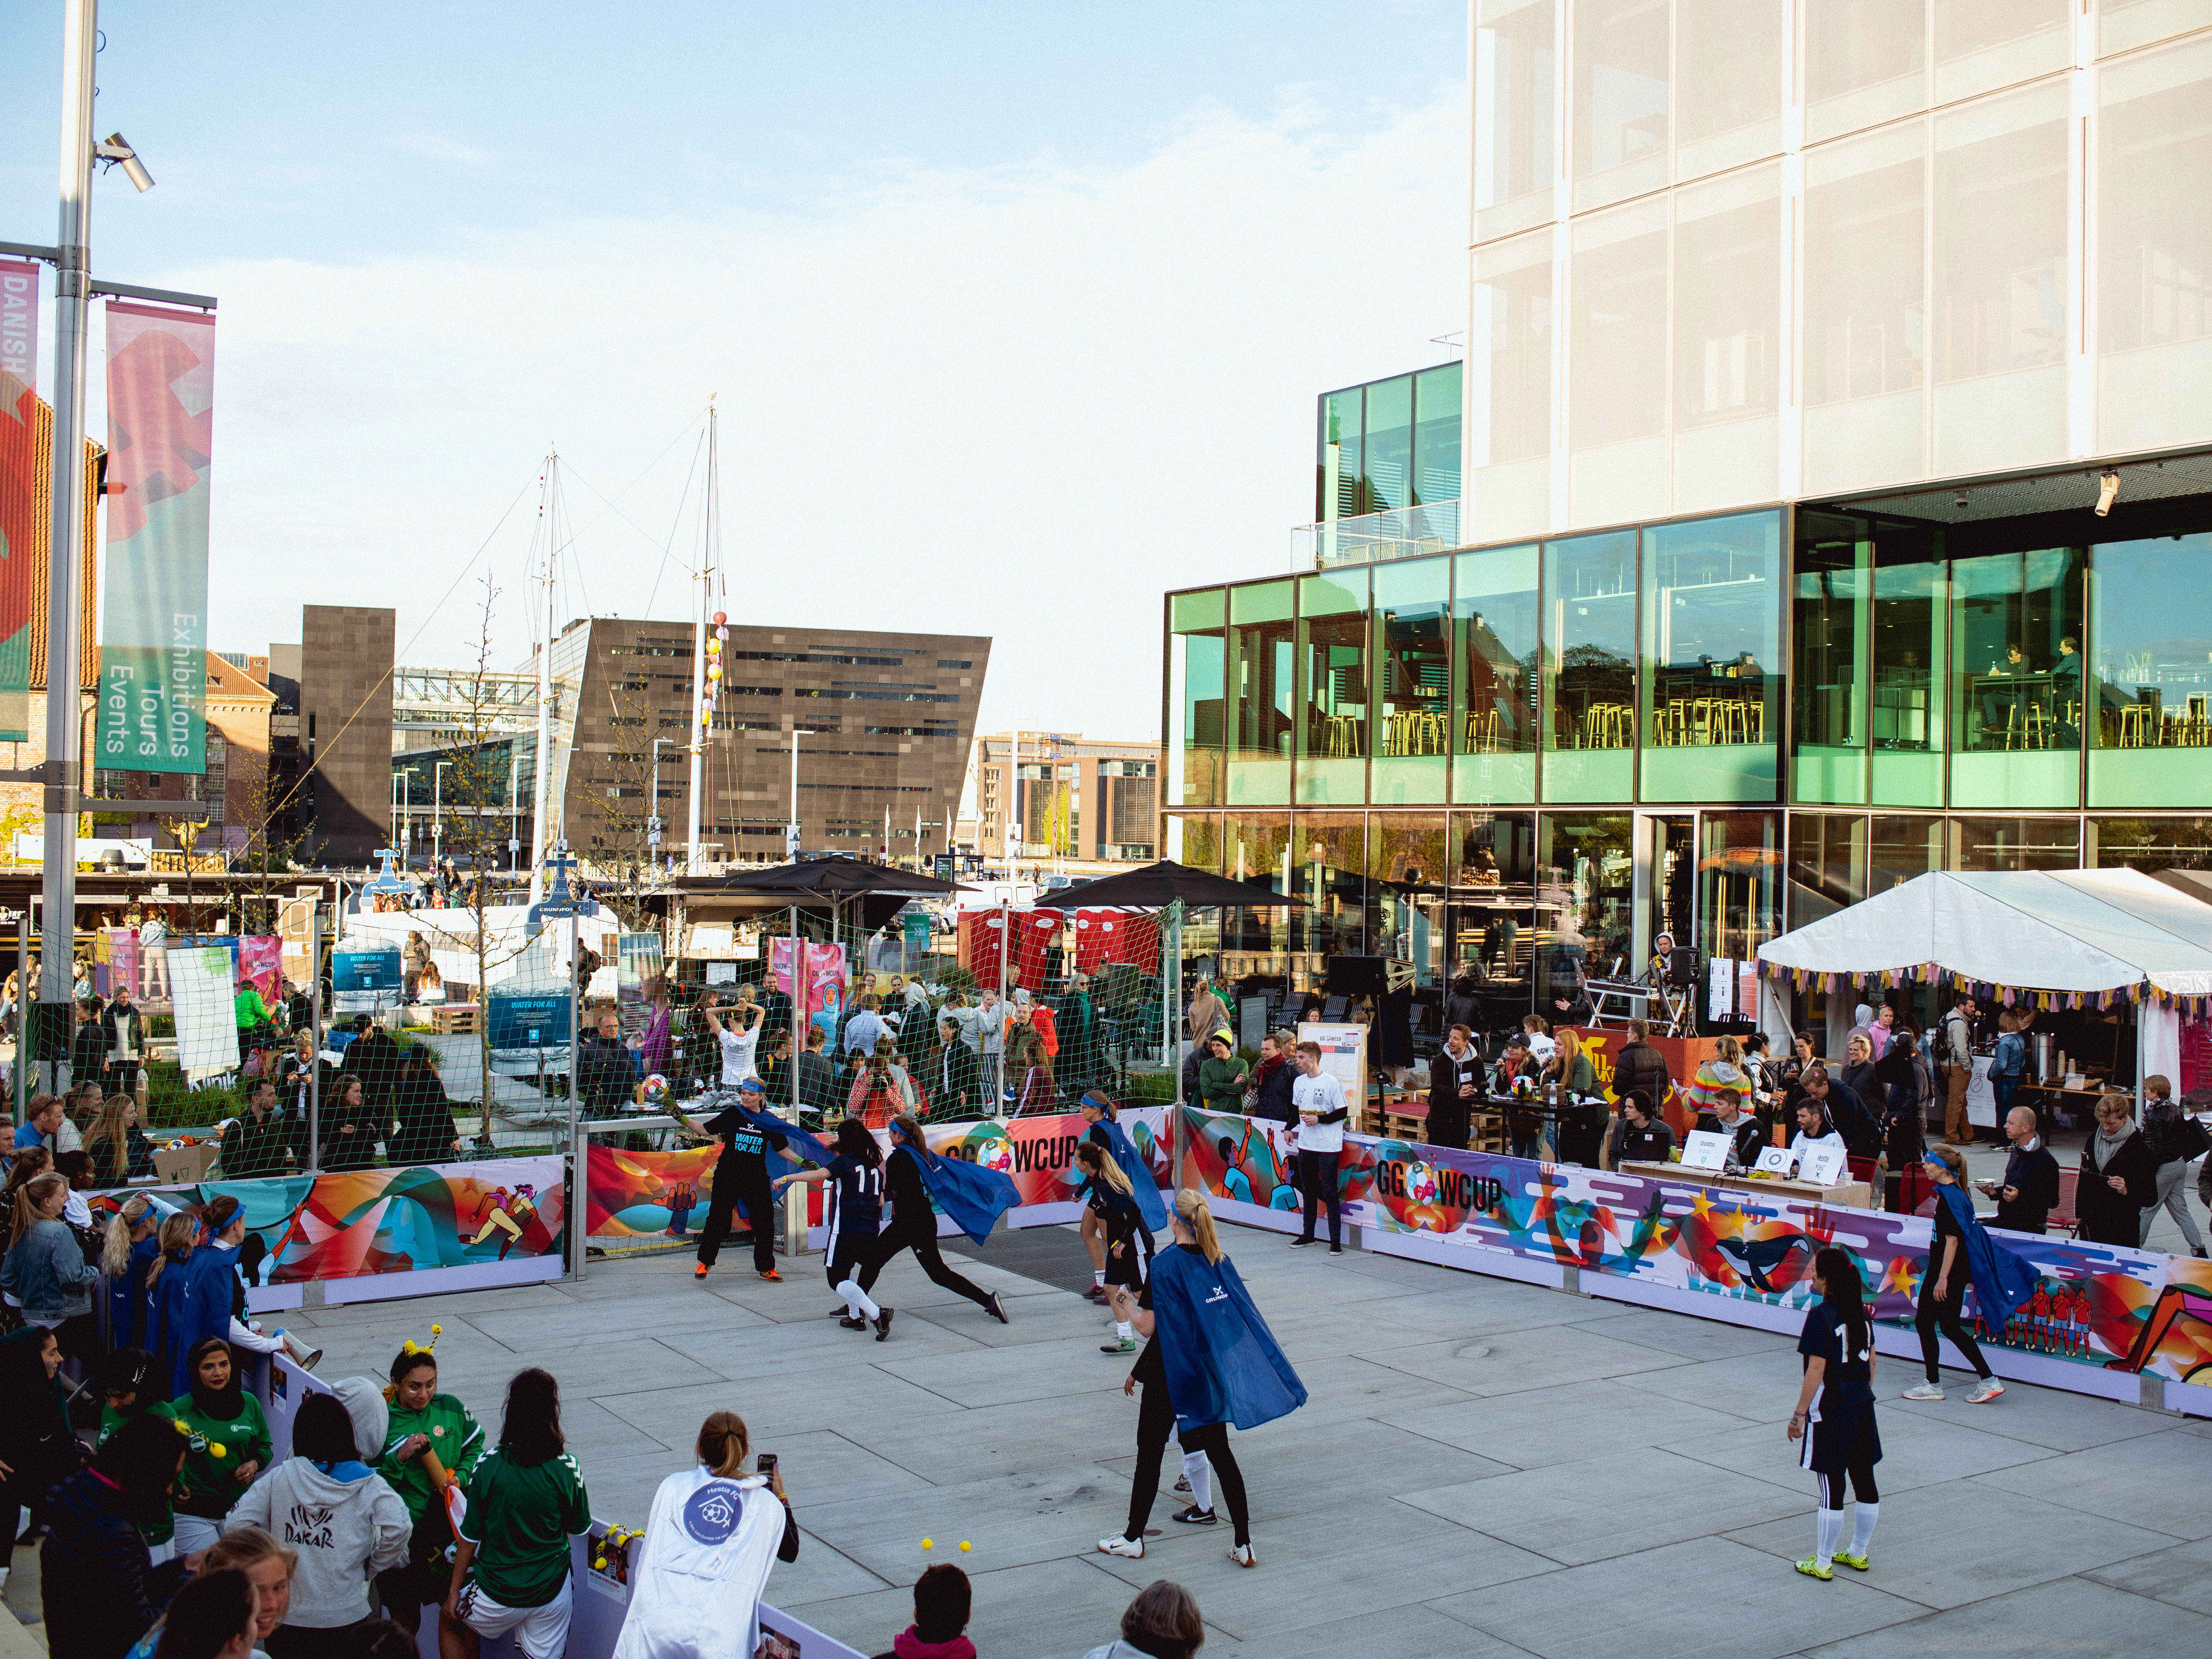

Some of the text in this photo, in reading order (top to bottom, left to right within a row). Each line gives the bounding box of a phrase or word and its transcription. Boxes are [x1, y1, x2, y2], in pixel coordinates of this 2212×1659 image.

[2, 276, 28, 373] DANISH
[172, 613, 196, 757] Exhibitions
[106, 665, 133, 753] Events
[140, 686, 164, 756] Tours
[1380, 938, 1398, 953] BLO
[188, 1071, 238, 1093] Klinik
[735, 1133, 763, 1146] WATER
[735, 1142, 762, 1154] FOR ALL
[1014, 1135, 1079, 1173] WCUP
[1817, 1154, 1829, 1162] Hestia
[855, 1165, 879, 1195] 11
[1377, 1160, 1502, 1214] GG WCUP
[390, 1434, 405, 1446] STANNO
[730, 1490, 739, 1500] FC
[285, 1522, 334, 1549] DAKAR
